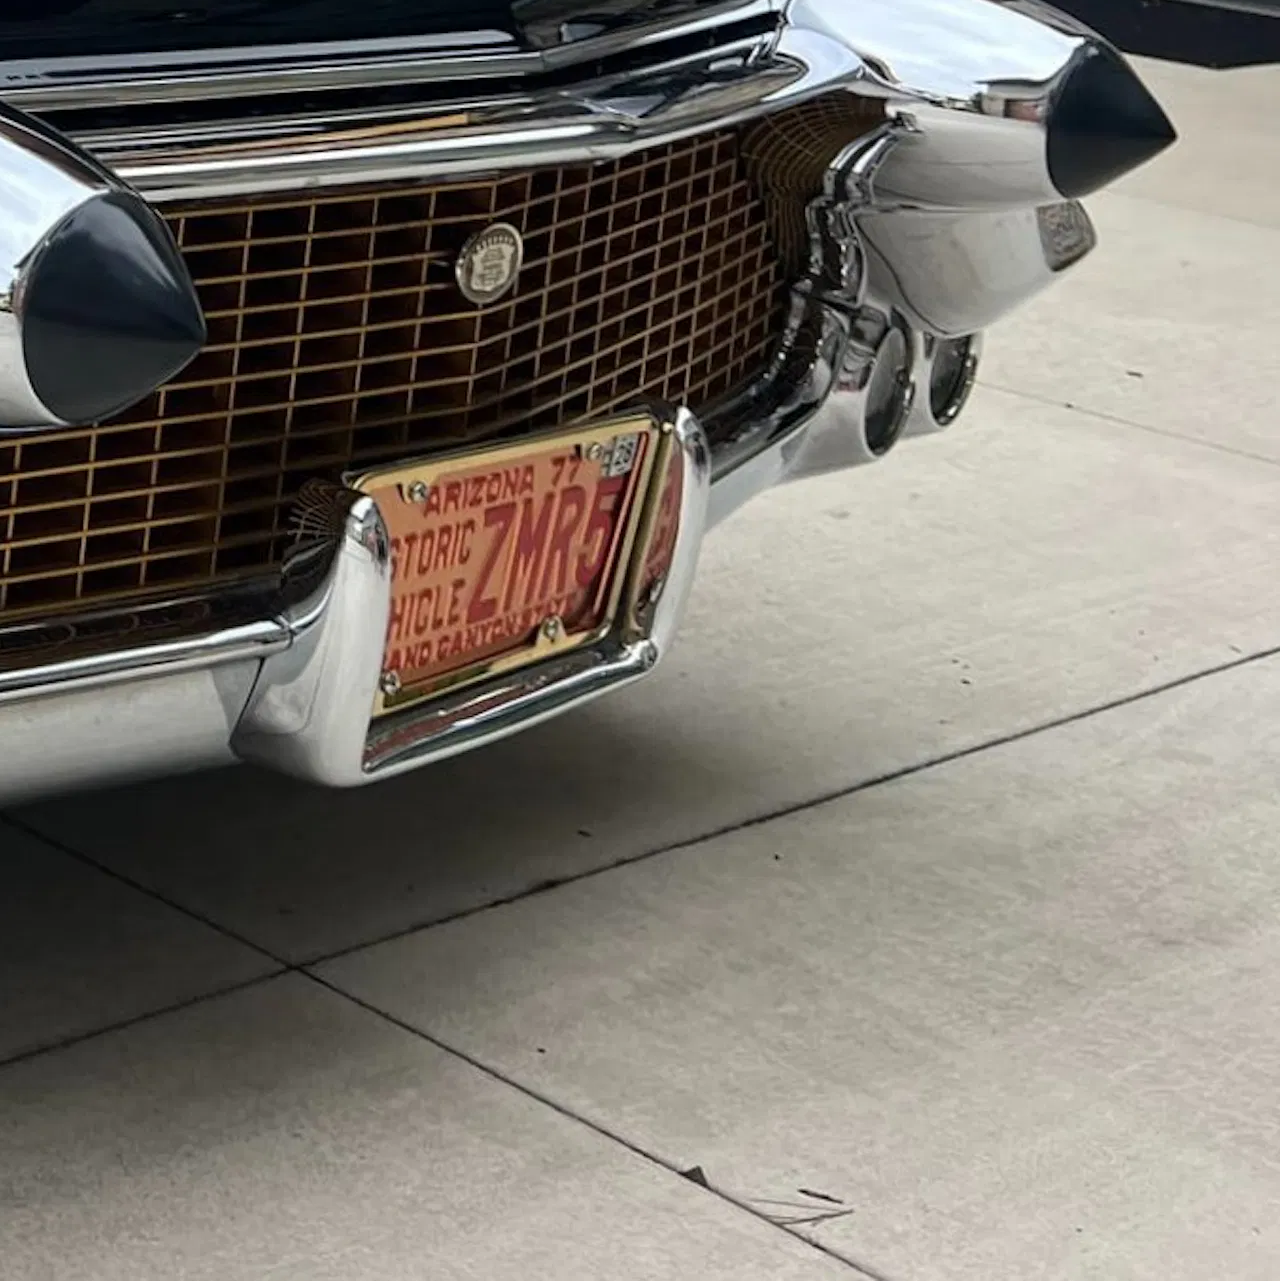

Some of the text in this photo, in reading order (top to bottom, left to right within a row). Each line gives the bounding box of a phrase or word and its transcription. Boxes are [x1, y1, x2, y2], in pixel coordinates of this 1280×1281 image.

[424, 464, 534, 517] ARIZONA
[390, 518, 475, 582] STORIC
[466, 477, 623, 625] ZMR5
[387, 577, 466, 641] HICLE
[386, 640, 432, 670] AND
